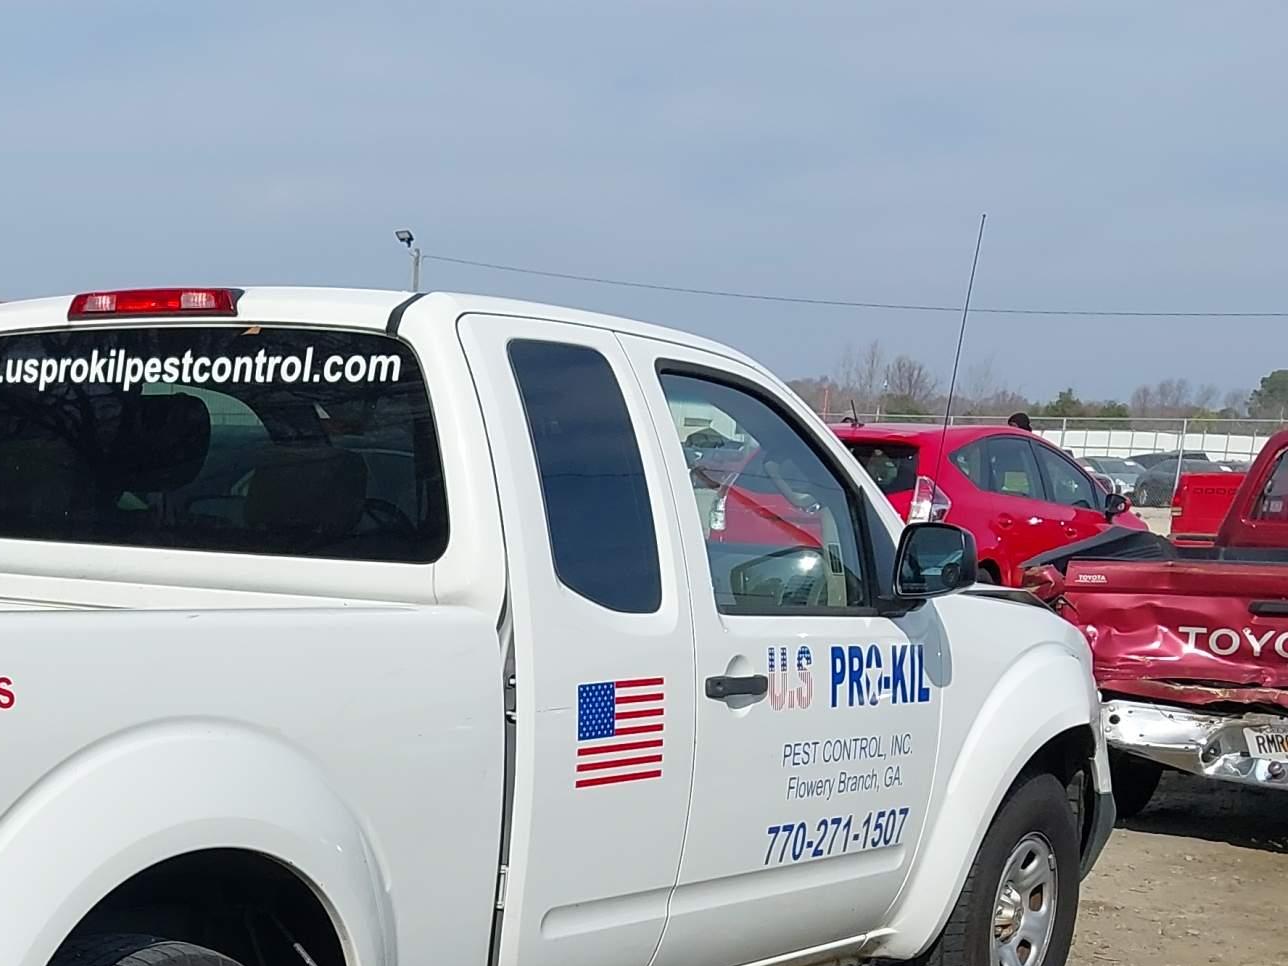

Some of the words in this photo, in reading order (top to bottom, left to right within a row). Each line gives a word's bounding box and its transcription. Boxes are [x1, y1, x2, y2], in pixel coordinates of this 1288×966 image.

[830, 644, 930, 708] PRO-KIL
[782, 741, 820, 767] PEST
[822, 736, 887, 762] CONTROL,
[890, 733, 913, 755] INC.
[1256, 734, 1288, 754] RMR
[786, 776, 836, 801] Flowery
[837, 768, 880, 793] Branch,
[884, 765, 904, 788] GA.
[764, 807, 910, 866] 770-271-1507
